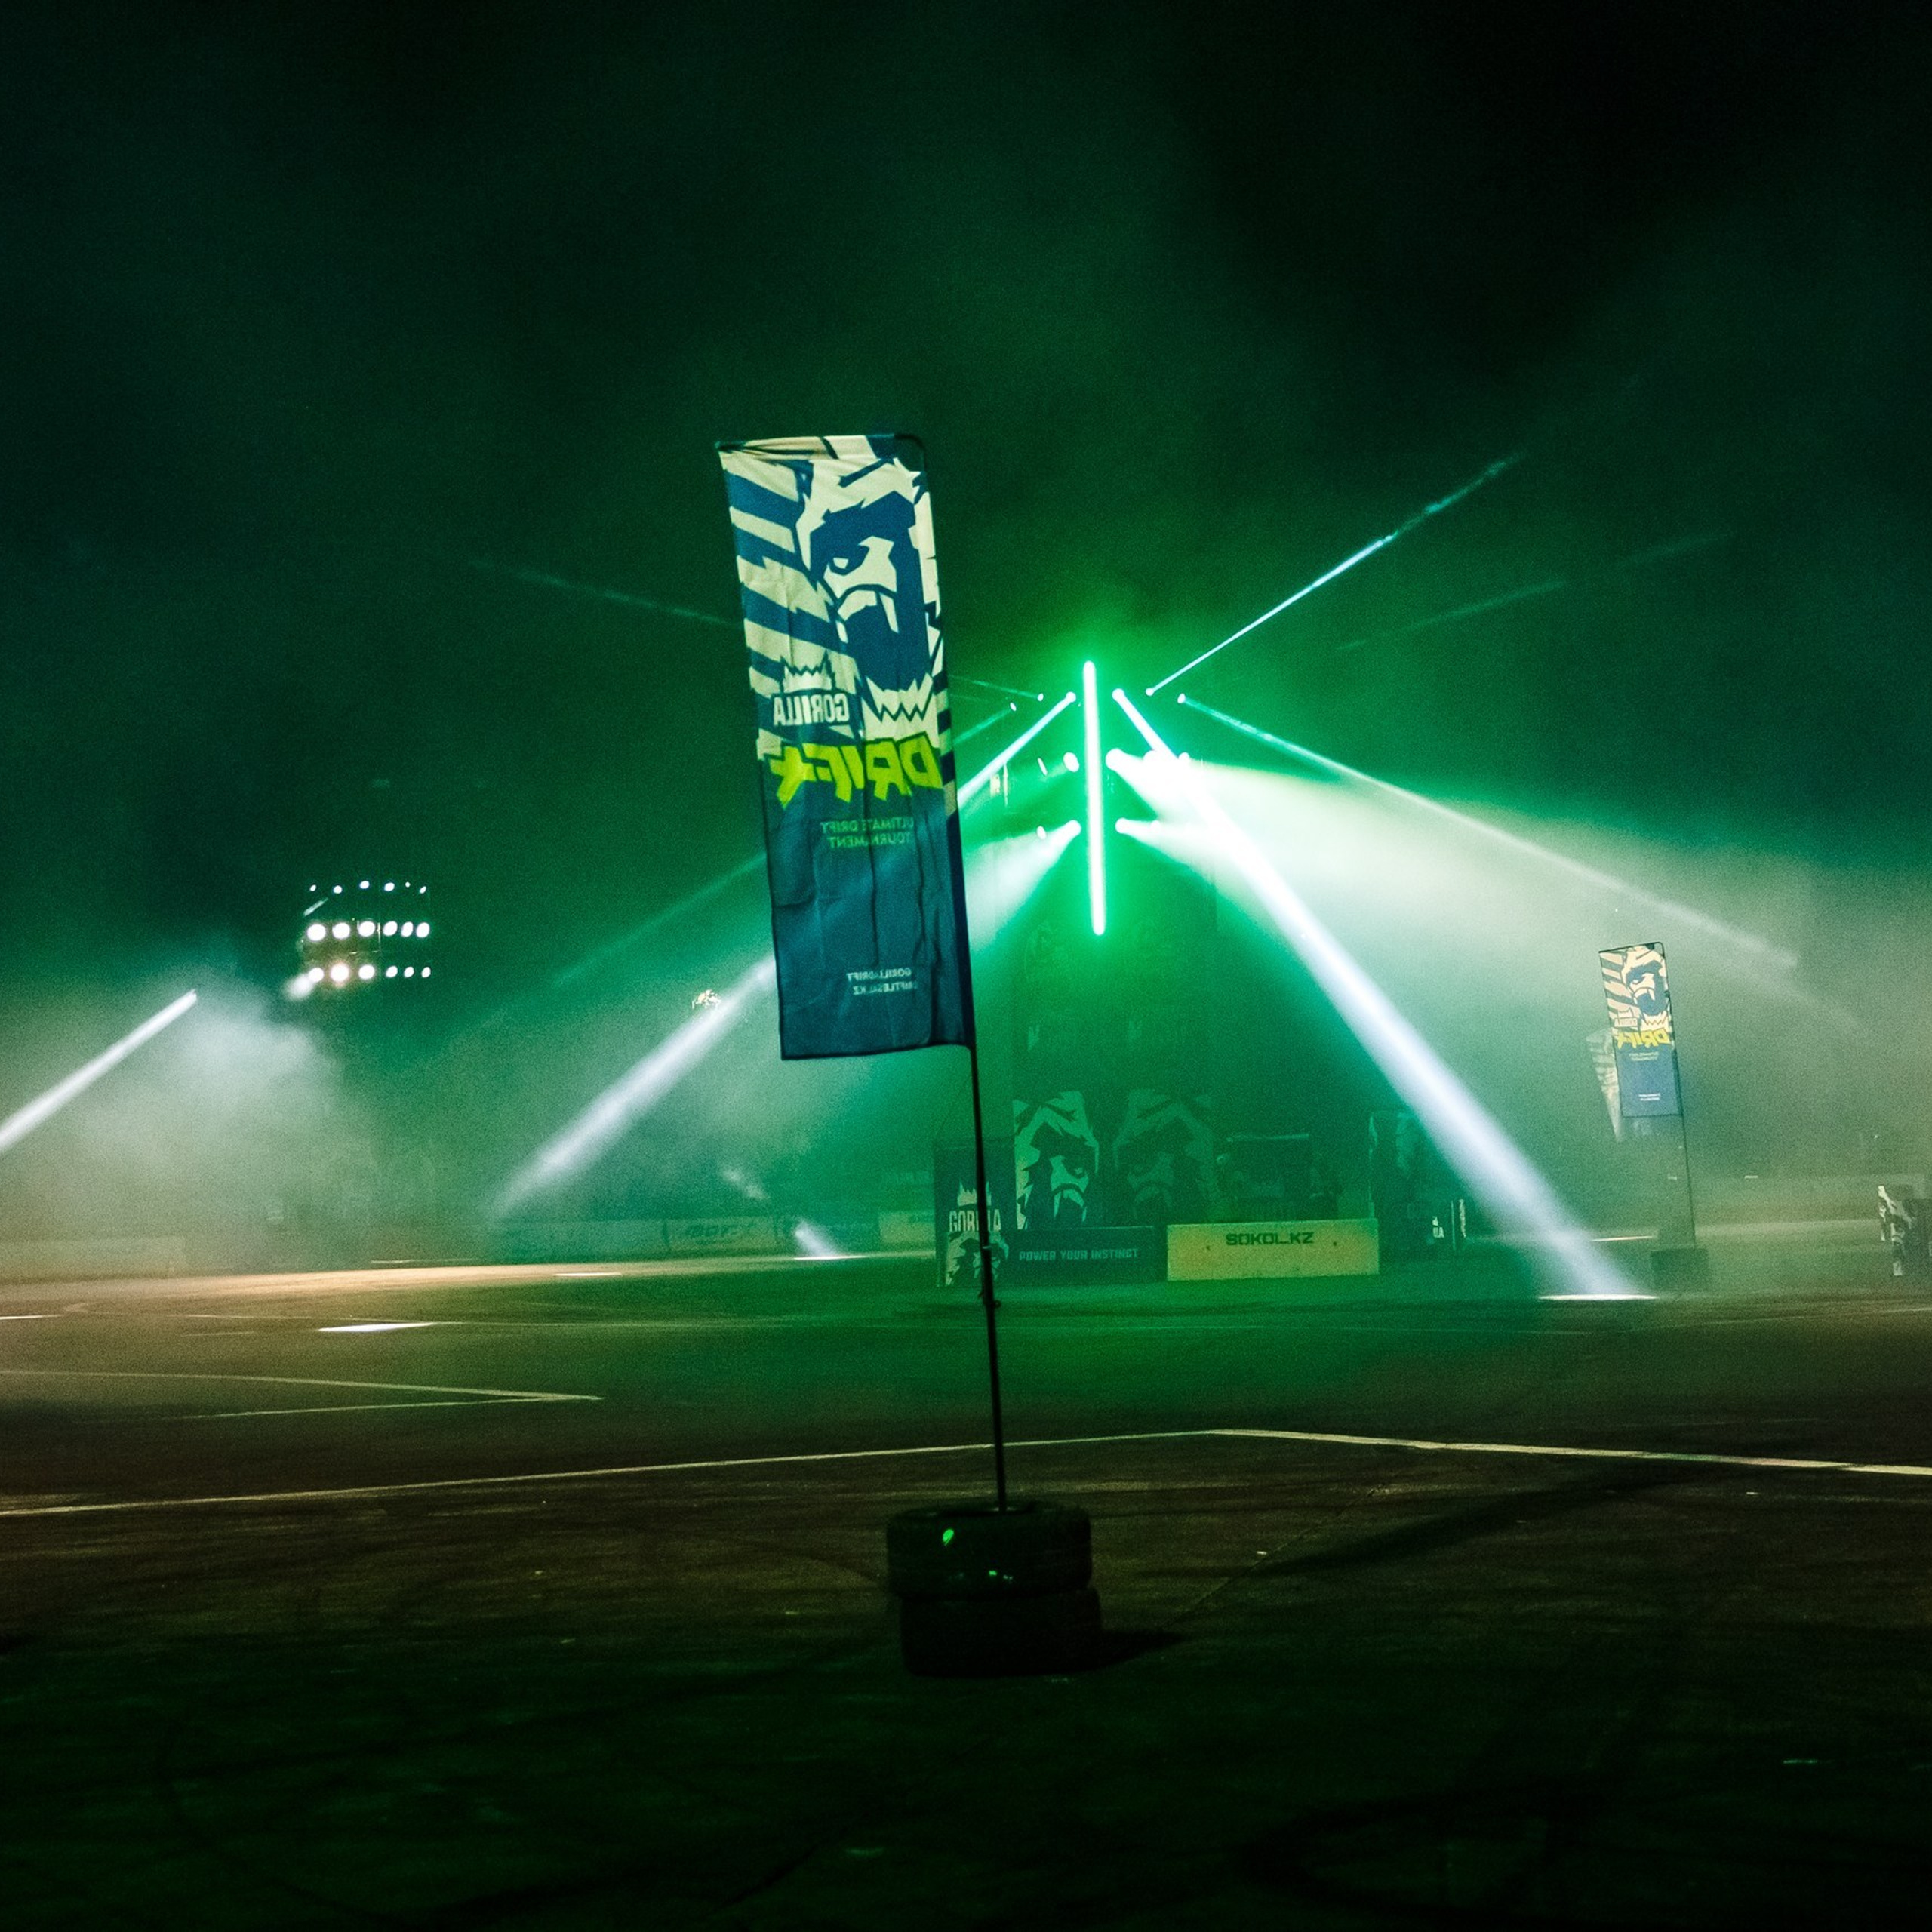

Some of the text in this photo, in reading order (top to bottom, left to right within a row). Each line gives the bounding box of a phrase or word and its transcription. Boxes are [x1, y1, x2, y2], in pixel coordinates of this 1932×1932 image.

[949, 1209, 1002, 1232] GORILA
[1226, 1232, 1315, 1246] SOKOL.KZ
[1019, 1248, 1139, 1261] POWER YOUR INSTINCT
